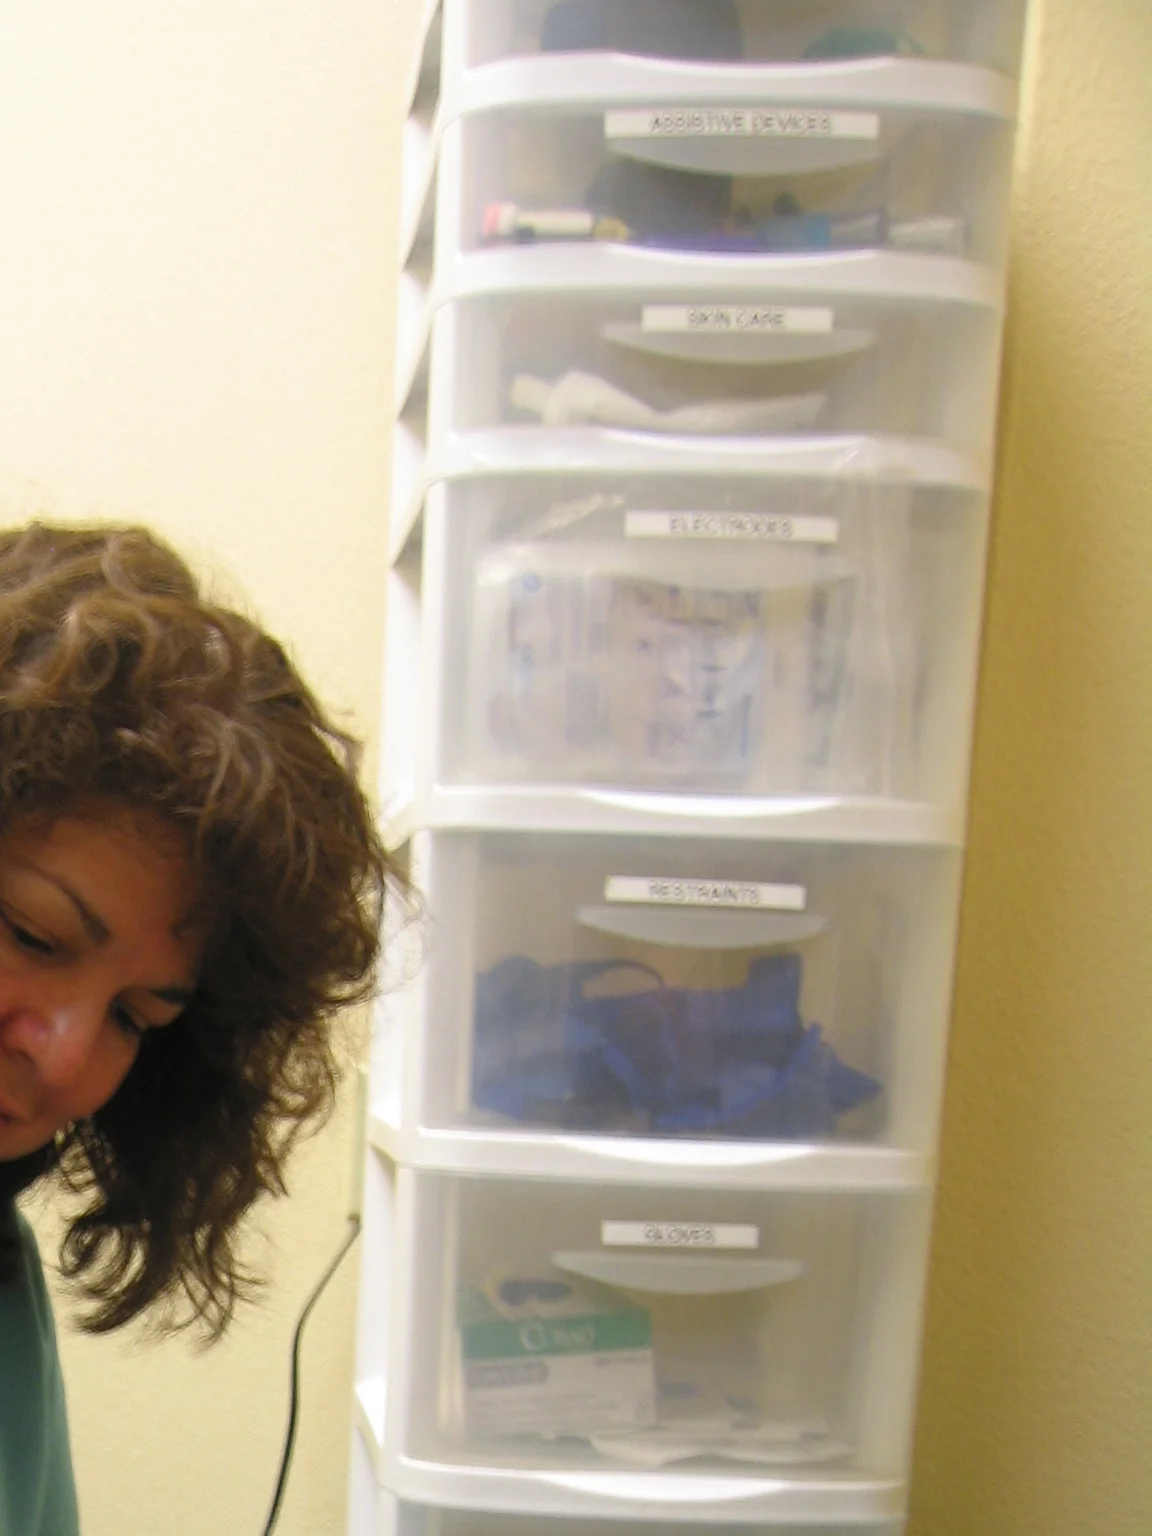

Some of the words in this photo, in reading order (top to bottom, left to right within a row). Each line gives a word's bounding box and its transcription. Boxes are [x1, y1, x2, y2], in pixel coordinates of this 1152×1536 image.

[651, 112, 744, 133] ASSISTIVE
[751, 112, 834, 134] DEVICES
[687, 308, 730, 328] SKIN
[736, 308, 784, 328] CARE
[645, 1225, 716, 1245] GLOVES
